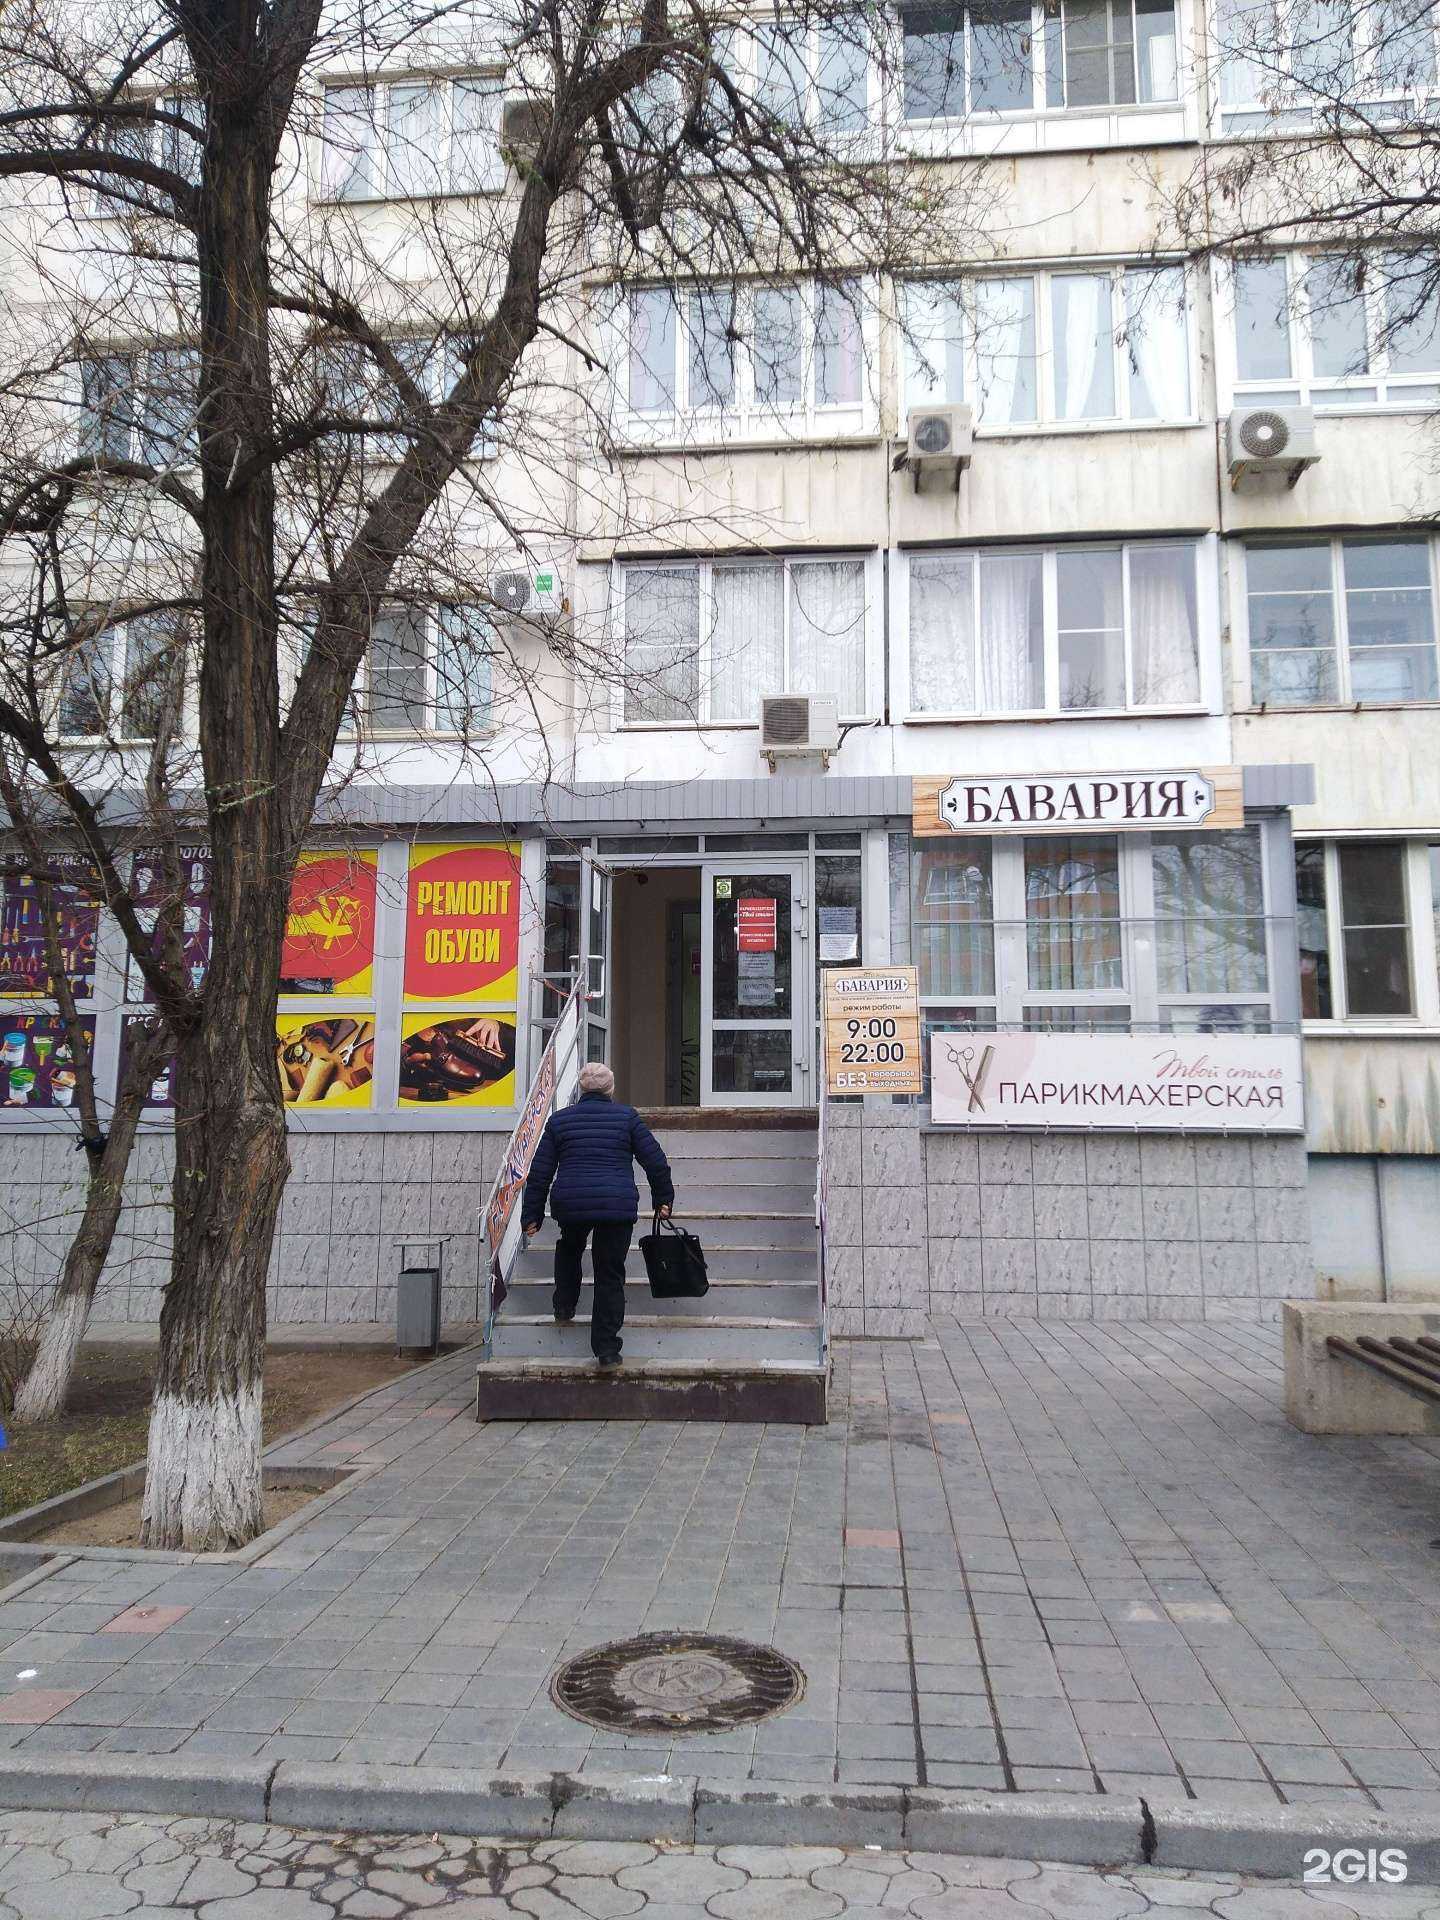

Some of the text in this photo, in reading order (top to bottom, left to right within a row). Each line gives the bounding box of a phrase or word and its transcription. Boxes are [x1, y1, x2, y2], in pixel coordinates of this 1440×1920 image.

[963, 780, 1188, 823] БАВАРИЯ
[417, 880, 511, 915] РЕМОНТ
[425, 928, 501, 964] ОБУВИ
[842, 979, 903, 992] БАВАРИЯ
[872, 1003, 902, 1011] работы
[847, 1018, 896, 1039] 9:00
[841, 1043, 904, 1063] 22:00
[1152, 1049, 1283, 1080] Твой стиль
[836, 1071, 867, 1088] БЕЗ
[999, 1082, 1284, 1108] ПАРИКМАХЕРСКАЯ
